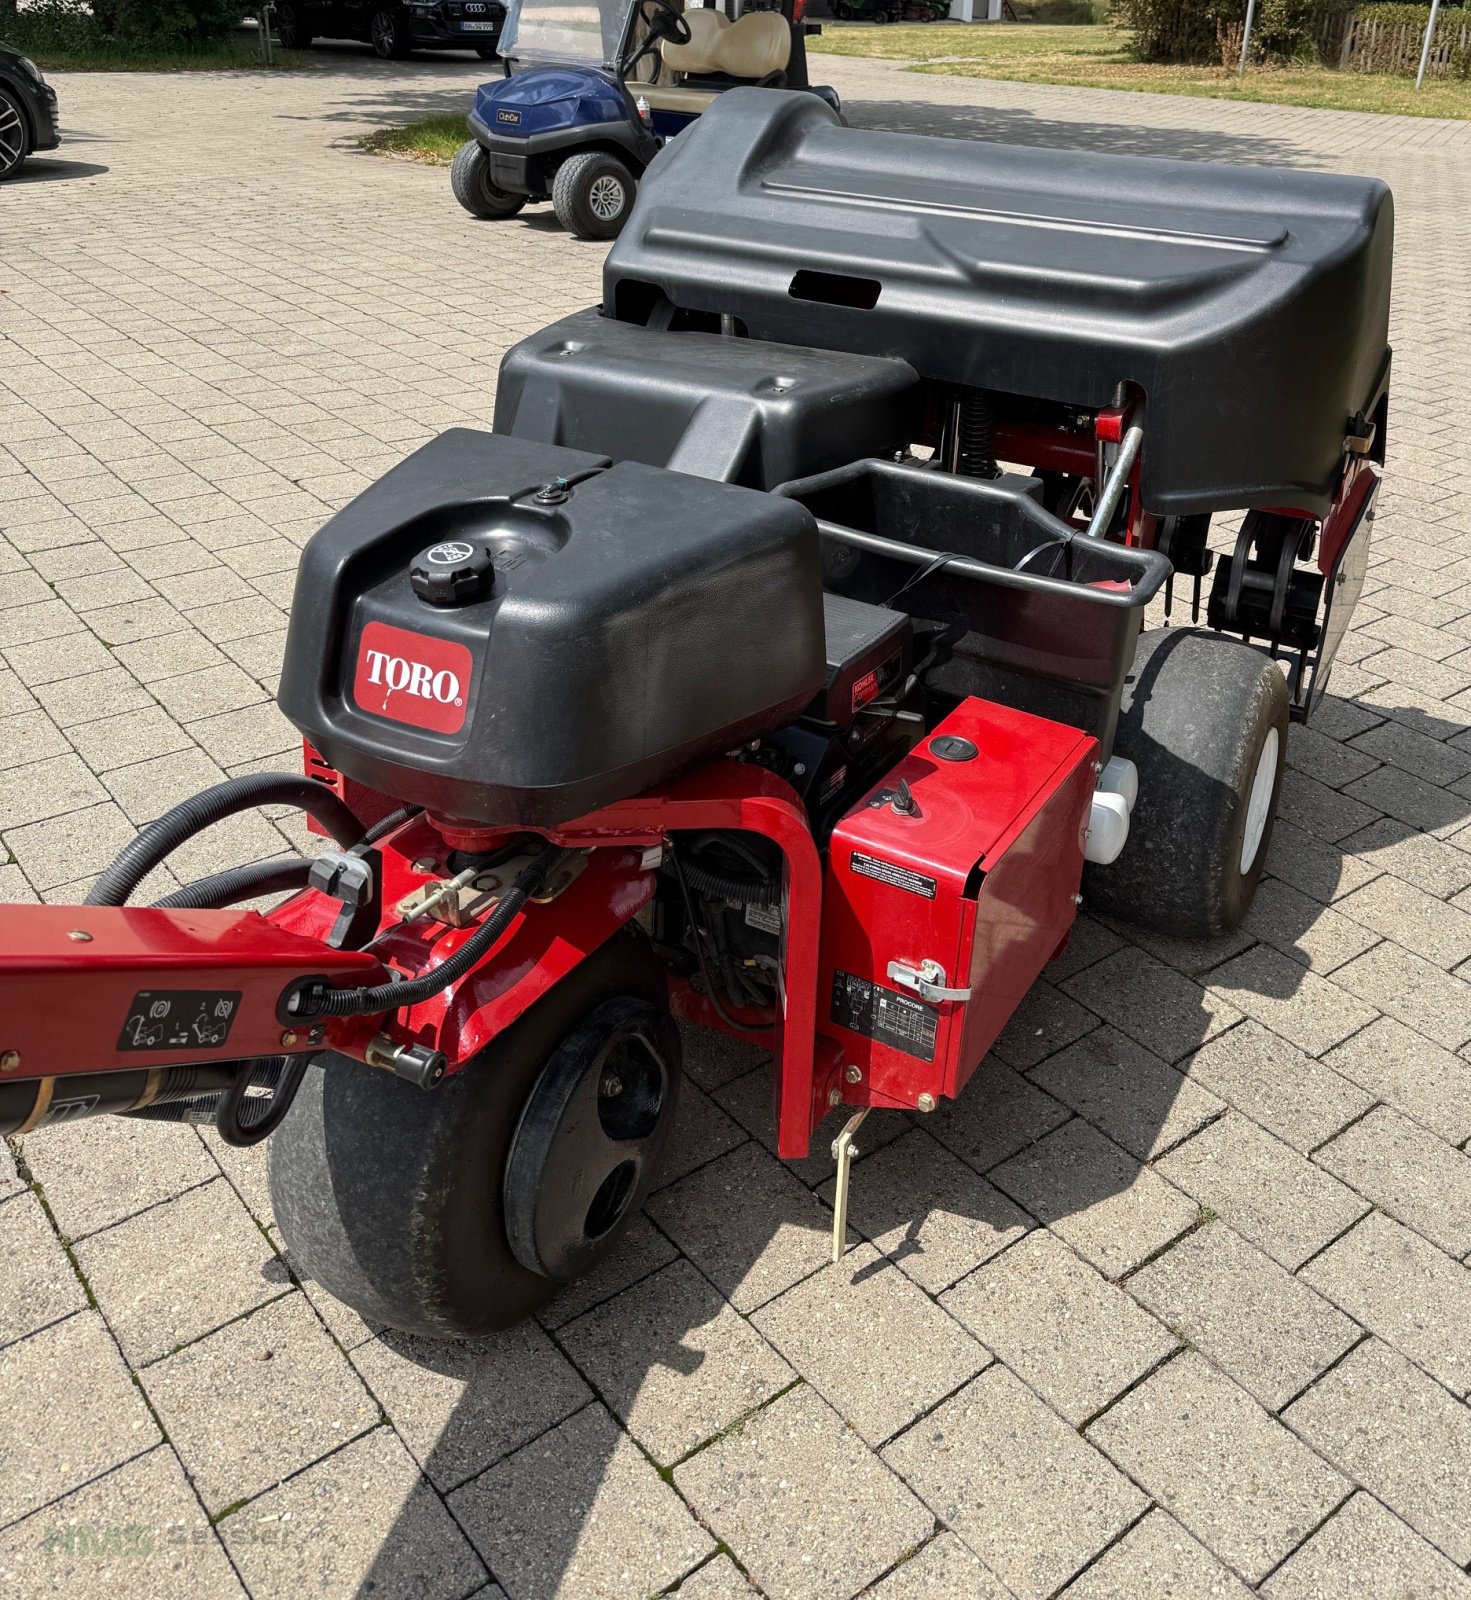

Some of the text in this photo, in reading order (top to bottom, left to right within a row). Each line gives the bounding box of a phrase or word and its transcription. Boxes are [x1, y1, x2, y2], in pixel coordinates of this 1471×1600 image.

[366, 649, 460, 704] TORO
[854, 673, 874, 693] KOHLER
[896, 996, 924, 1012] PROCORE
